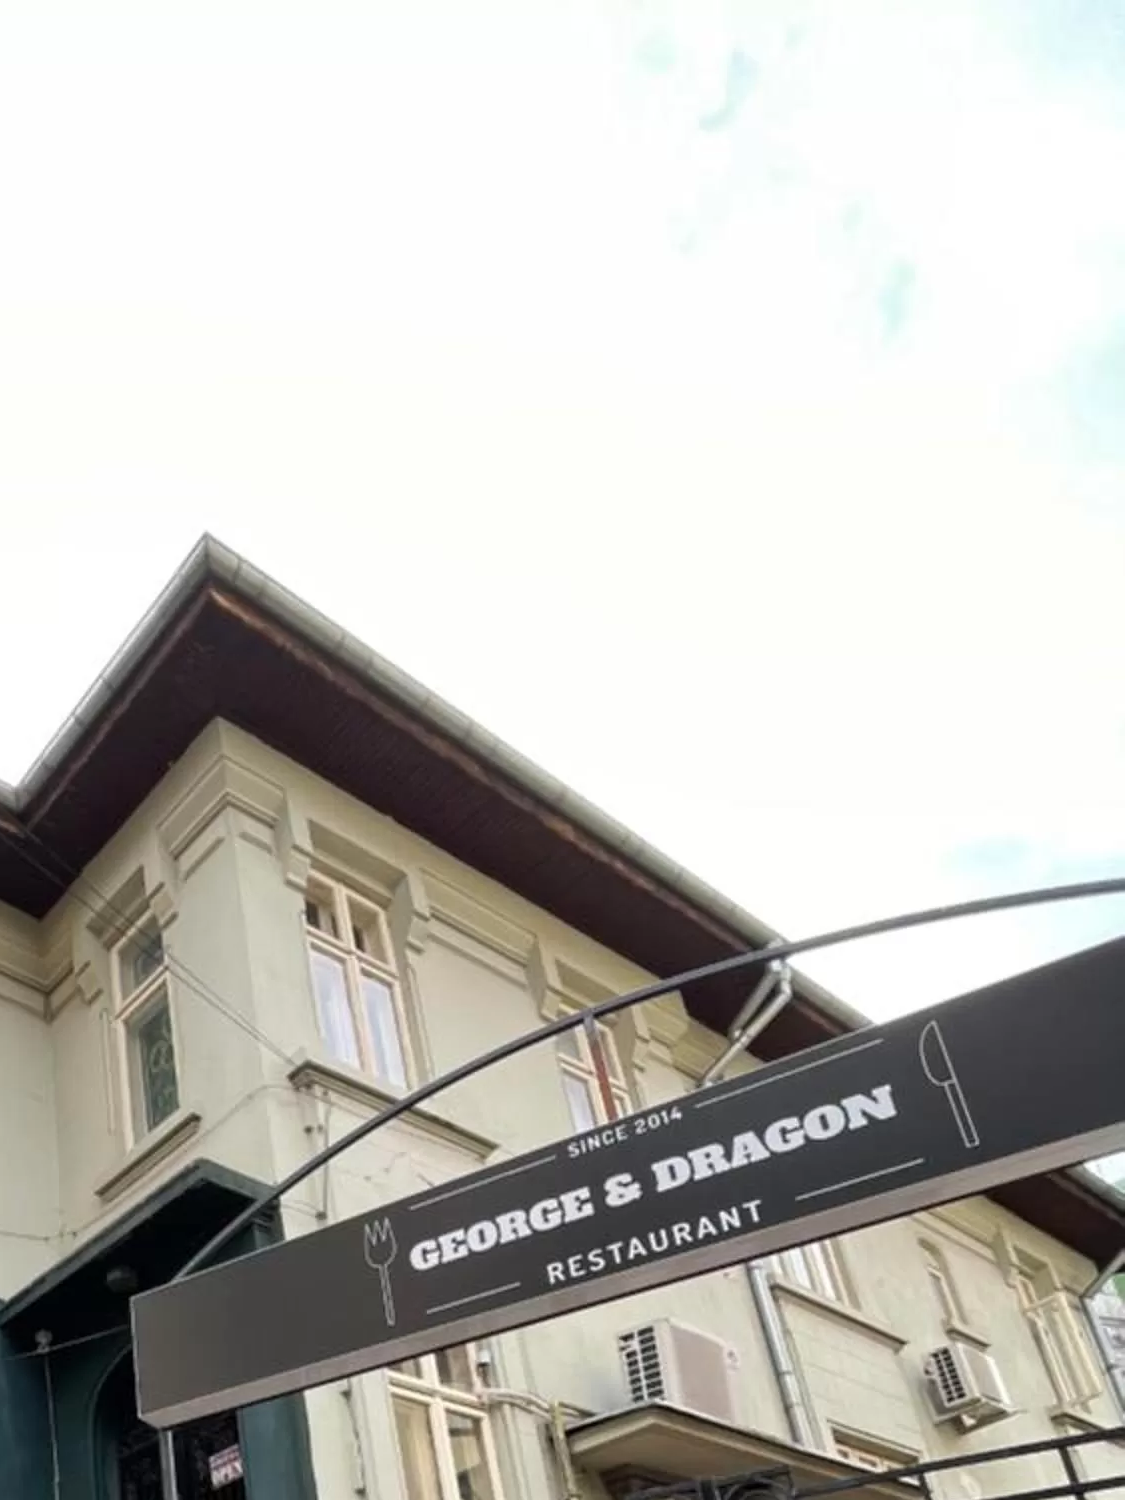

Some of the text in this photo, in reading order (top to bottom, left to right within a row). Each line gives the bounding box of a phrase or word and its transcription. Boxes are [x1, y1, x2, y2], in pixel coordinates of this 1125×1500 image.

[567, 1106, 683, 1159] SINCE 2014
[409, 1084, 897, 1271] GEORGE & DRAGON
[546, 1199, 762, 1285] RESTAURANT
